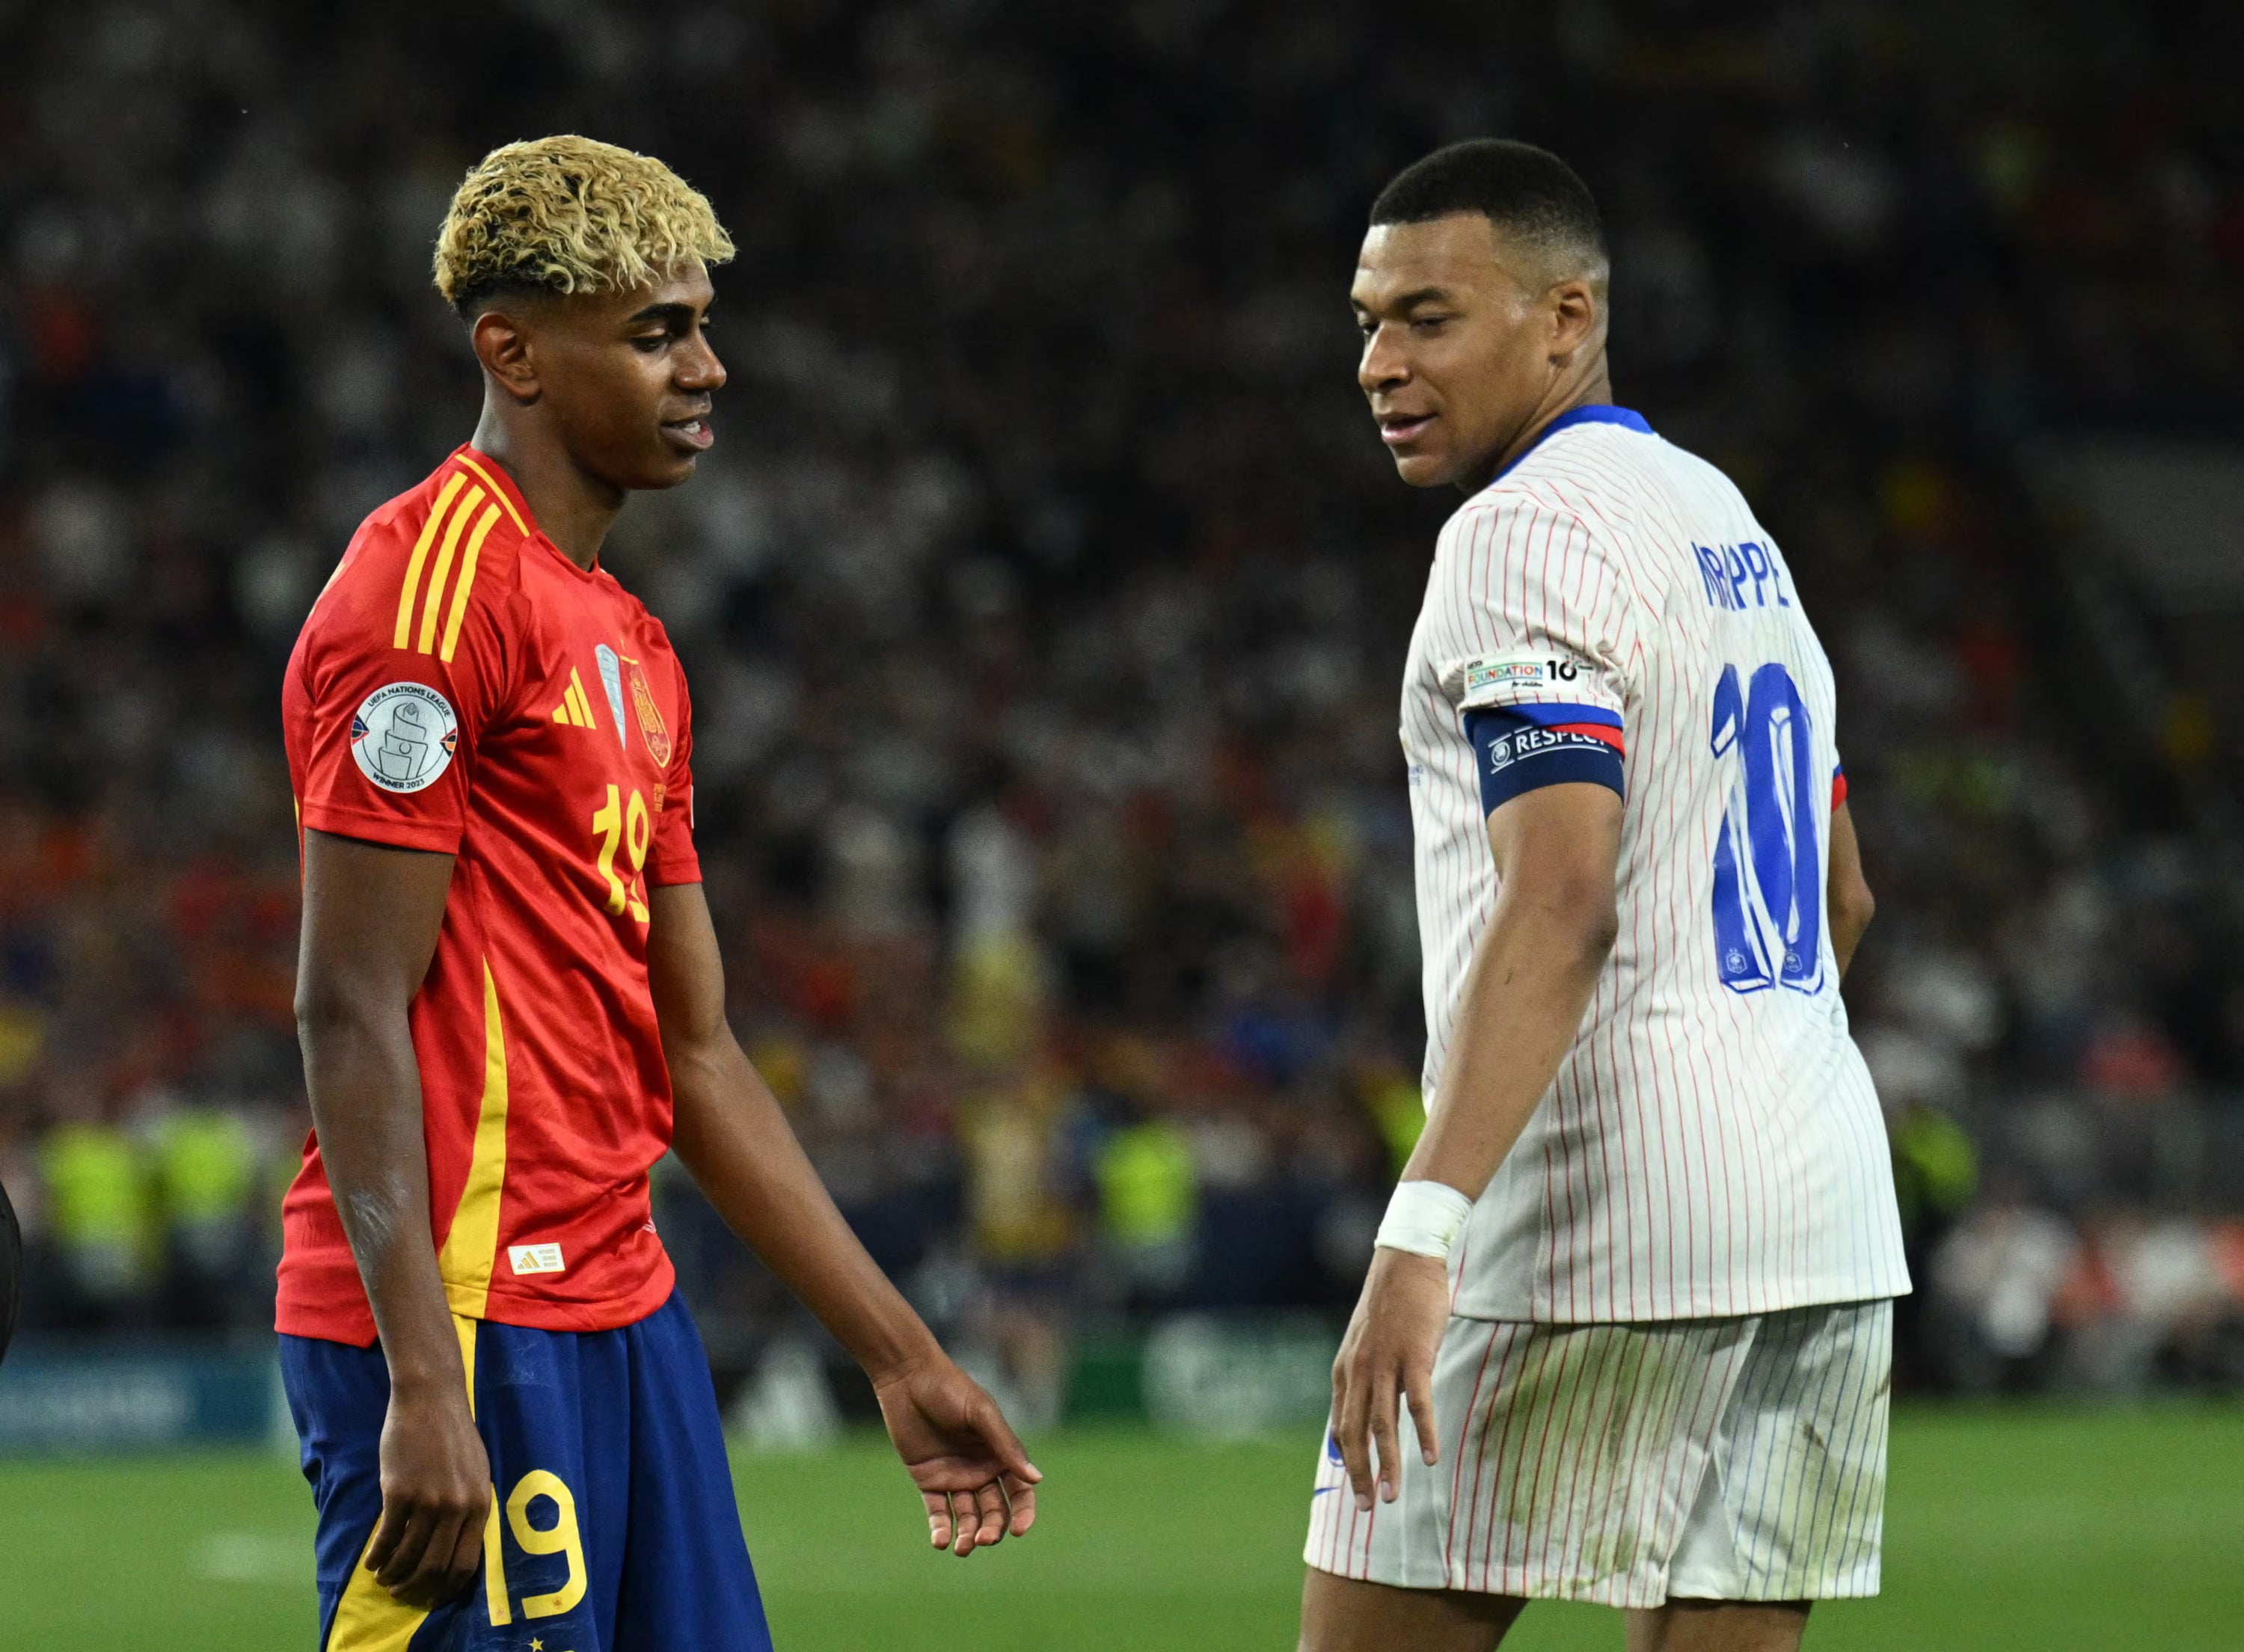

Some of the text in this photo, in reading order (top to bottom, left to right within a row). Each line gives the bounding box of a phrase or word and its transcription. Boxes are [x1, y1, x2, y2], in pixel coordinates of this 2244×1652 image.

[1468, 665, 1543, 684] FOUNDATION
[1546, 660, 1578, 681] 10
[368, 686, 451, 717] UEFA NATIONS LEAGUE
[1515, 729, 1605, 754] RESP
[373, 772, 426, 789] WINNER 2023
[1711, 662, 1824, 996] 10
[592, 784, 650, 924] 19
[483, 1469, 588, 1627] 19
